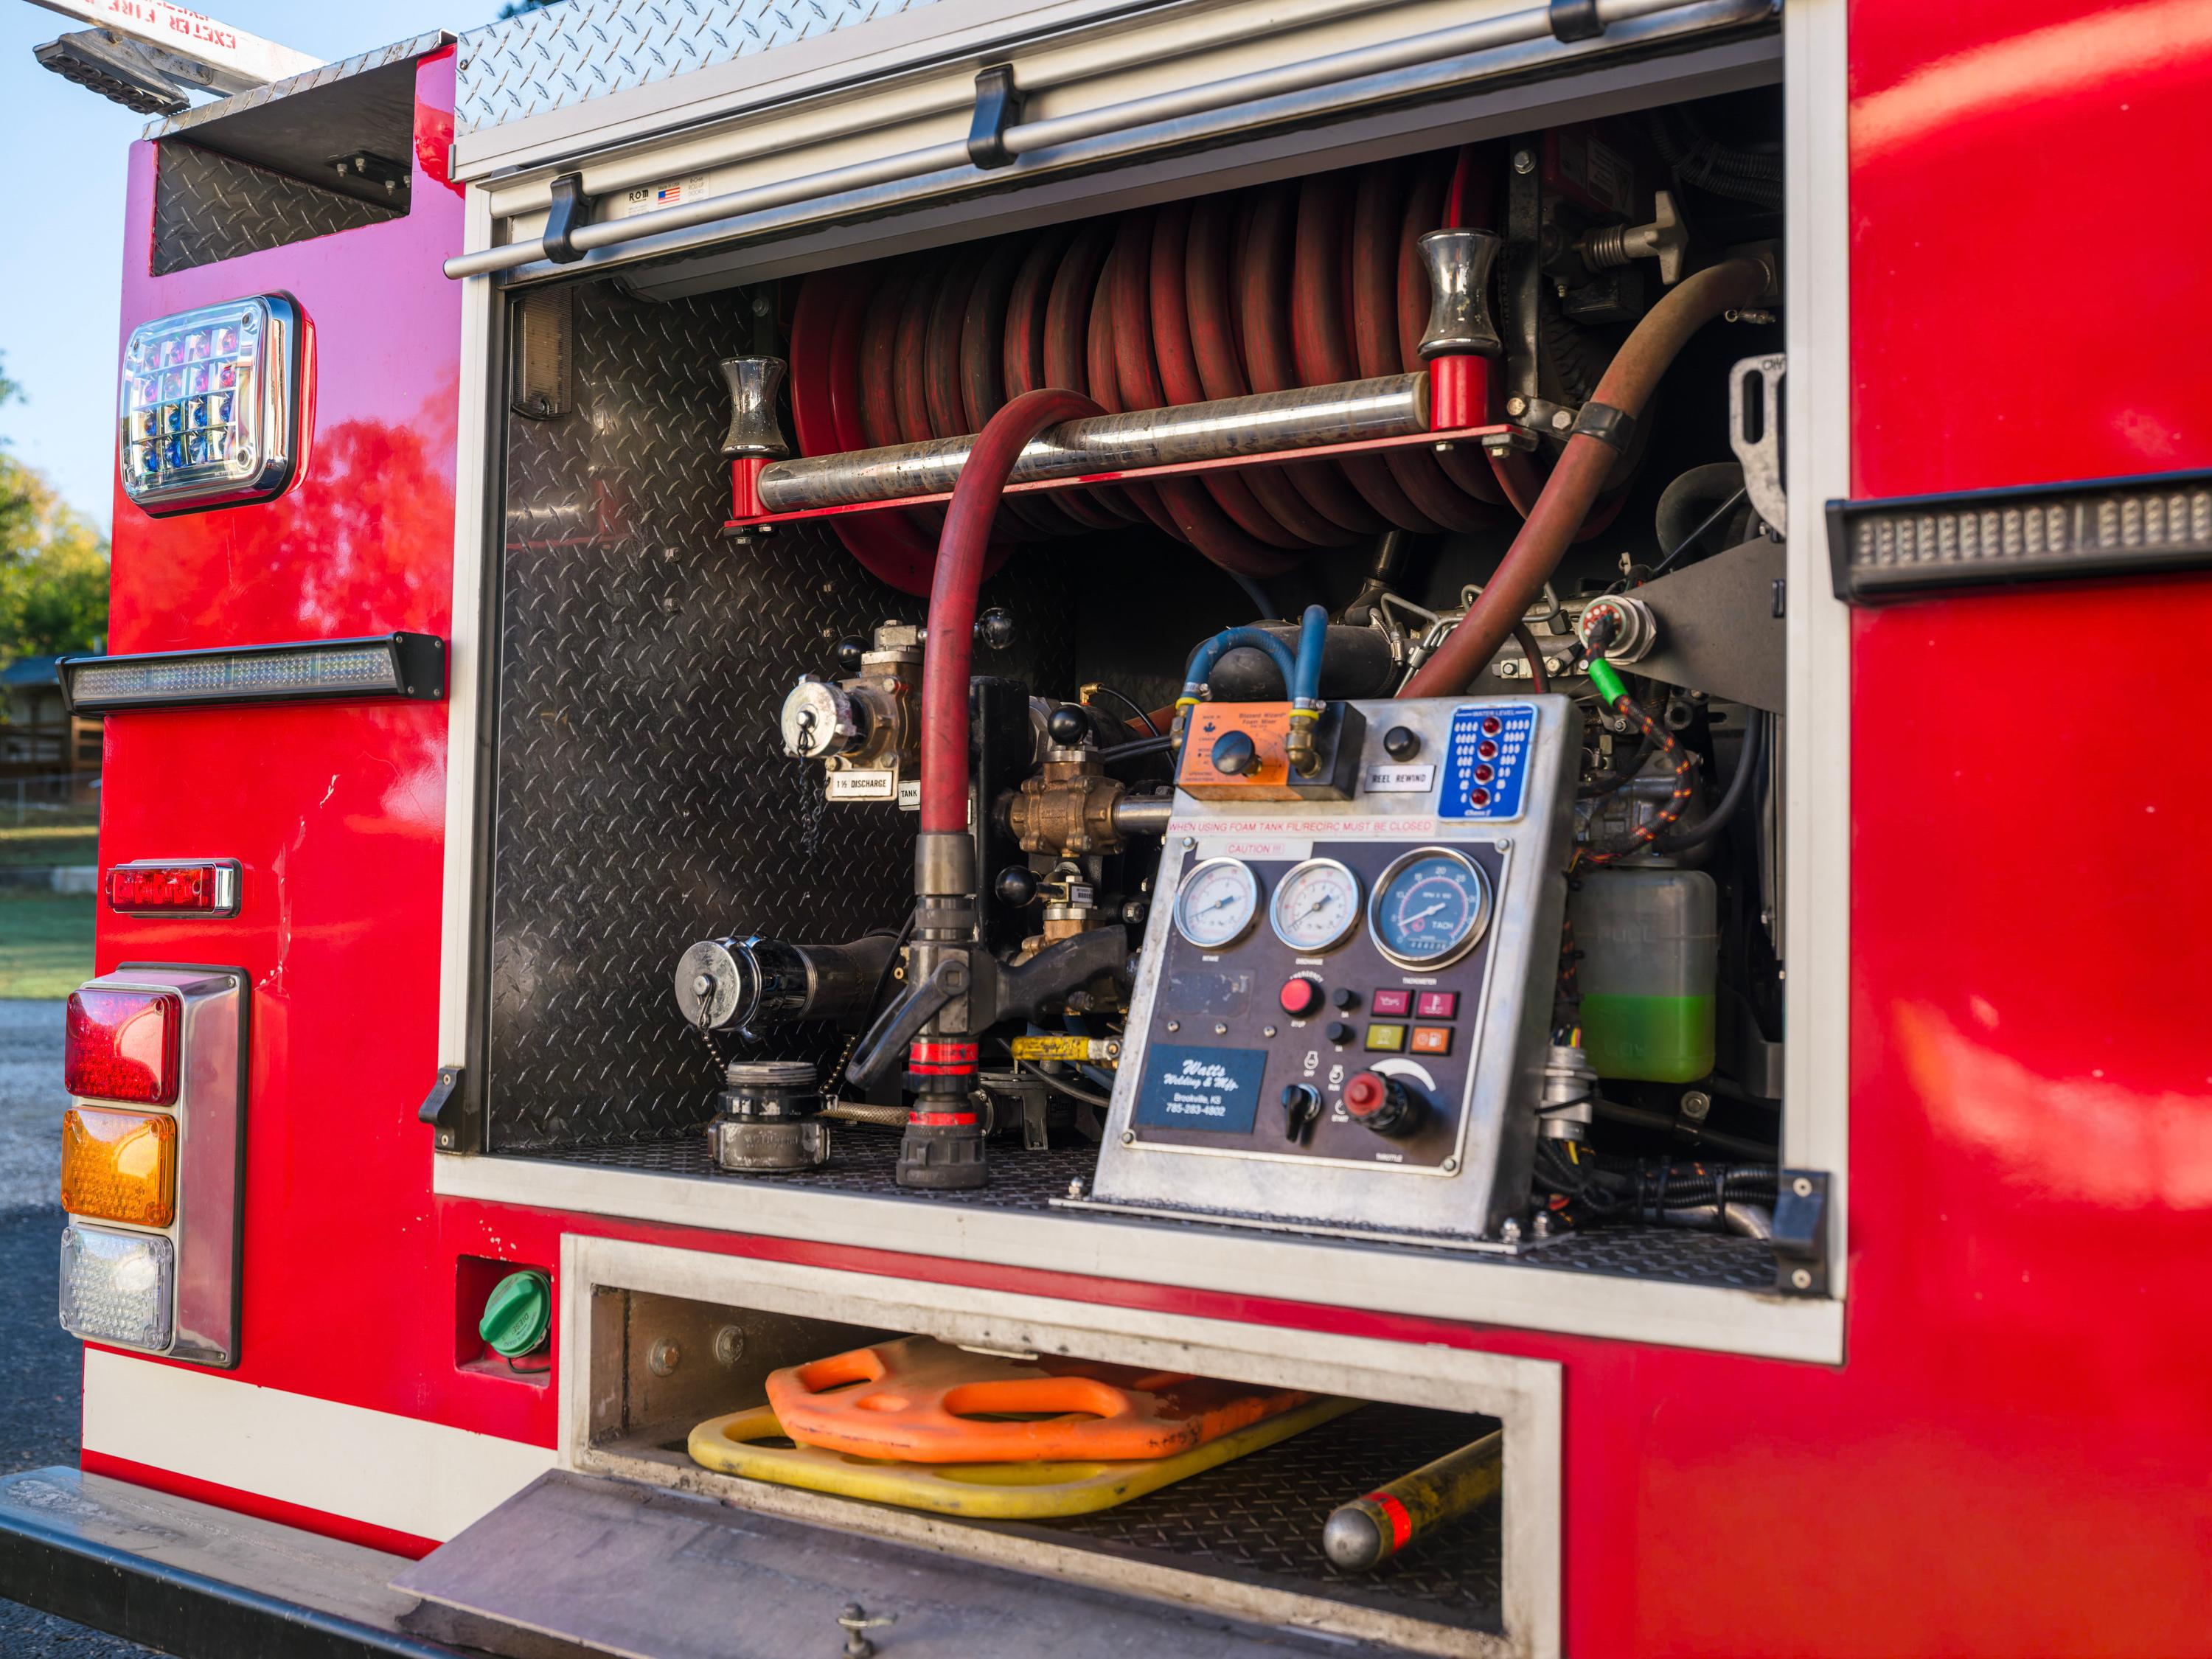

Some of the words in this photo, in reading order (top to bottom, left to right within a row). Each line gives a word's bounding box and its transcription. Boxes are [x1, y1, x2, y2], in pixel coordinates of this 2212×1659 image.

[108, 0, 156, 24] FIRE
[170, 15, 236, 49] EXETER
[851, 779, 887, 788] DISCHARGE
[1371, 775, 1391, 784] REEL
[1396, 774, 1426, 783] REWIND
[901, 790, 918, 798] TANK
[1169, 823, 1196, 831] WHEN
[1198, 823, 1227, 831] USING
[1229, 823, 1257, 831] FOAM
[1260, 822, 1284, 831] TANK
[1343, 822, 1371, 831] MUST
[1374, 822, 1388, 831] BE
[1389, 821, 1432, 831] CLOSED
[1228, 845, 1270, 854] CAUTION
[1436, 866, 1447, 874] 20
[1432, 922, 1454, 931] TACH
[1182, 1059, 1226, 1077] Watts
[1163, 1073, 1202, 1090] Welding
[1203, 1076, 1213, 1087] &
[1173, 1092, 1210, 1105] Brookville,
[1209, 1095, 1222, 1105] KS
[1375, 1152, 1404, 1162] THROTTLE
